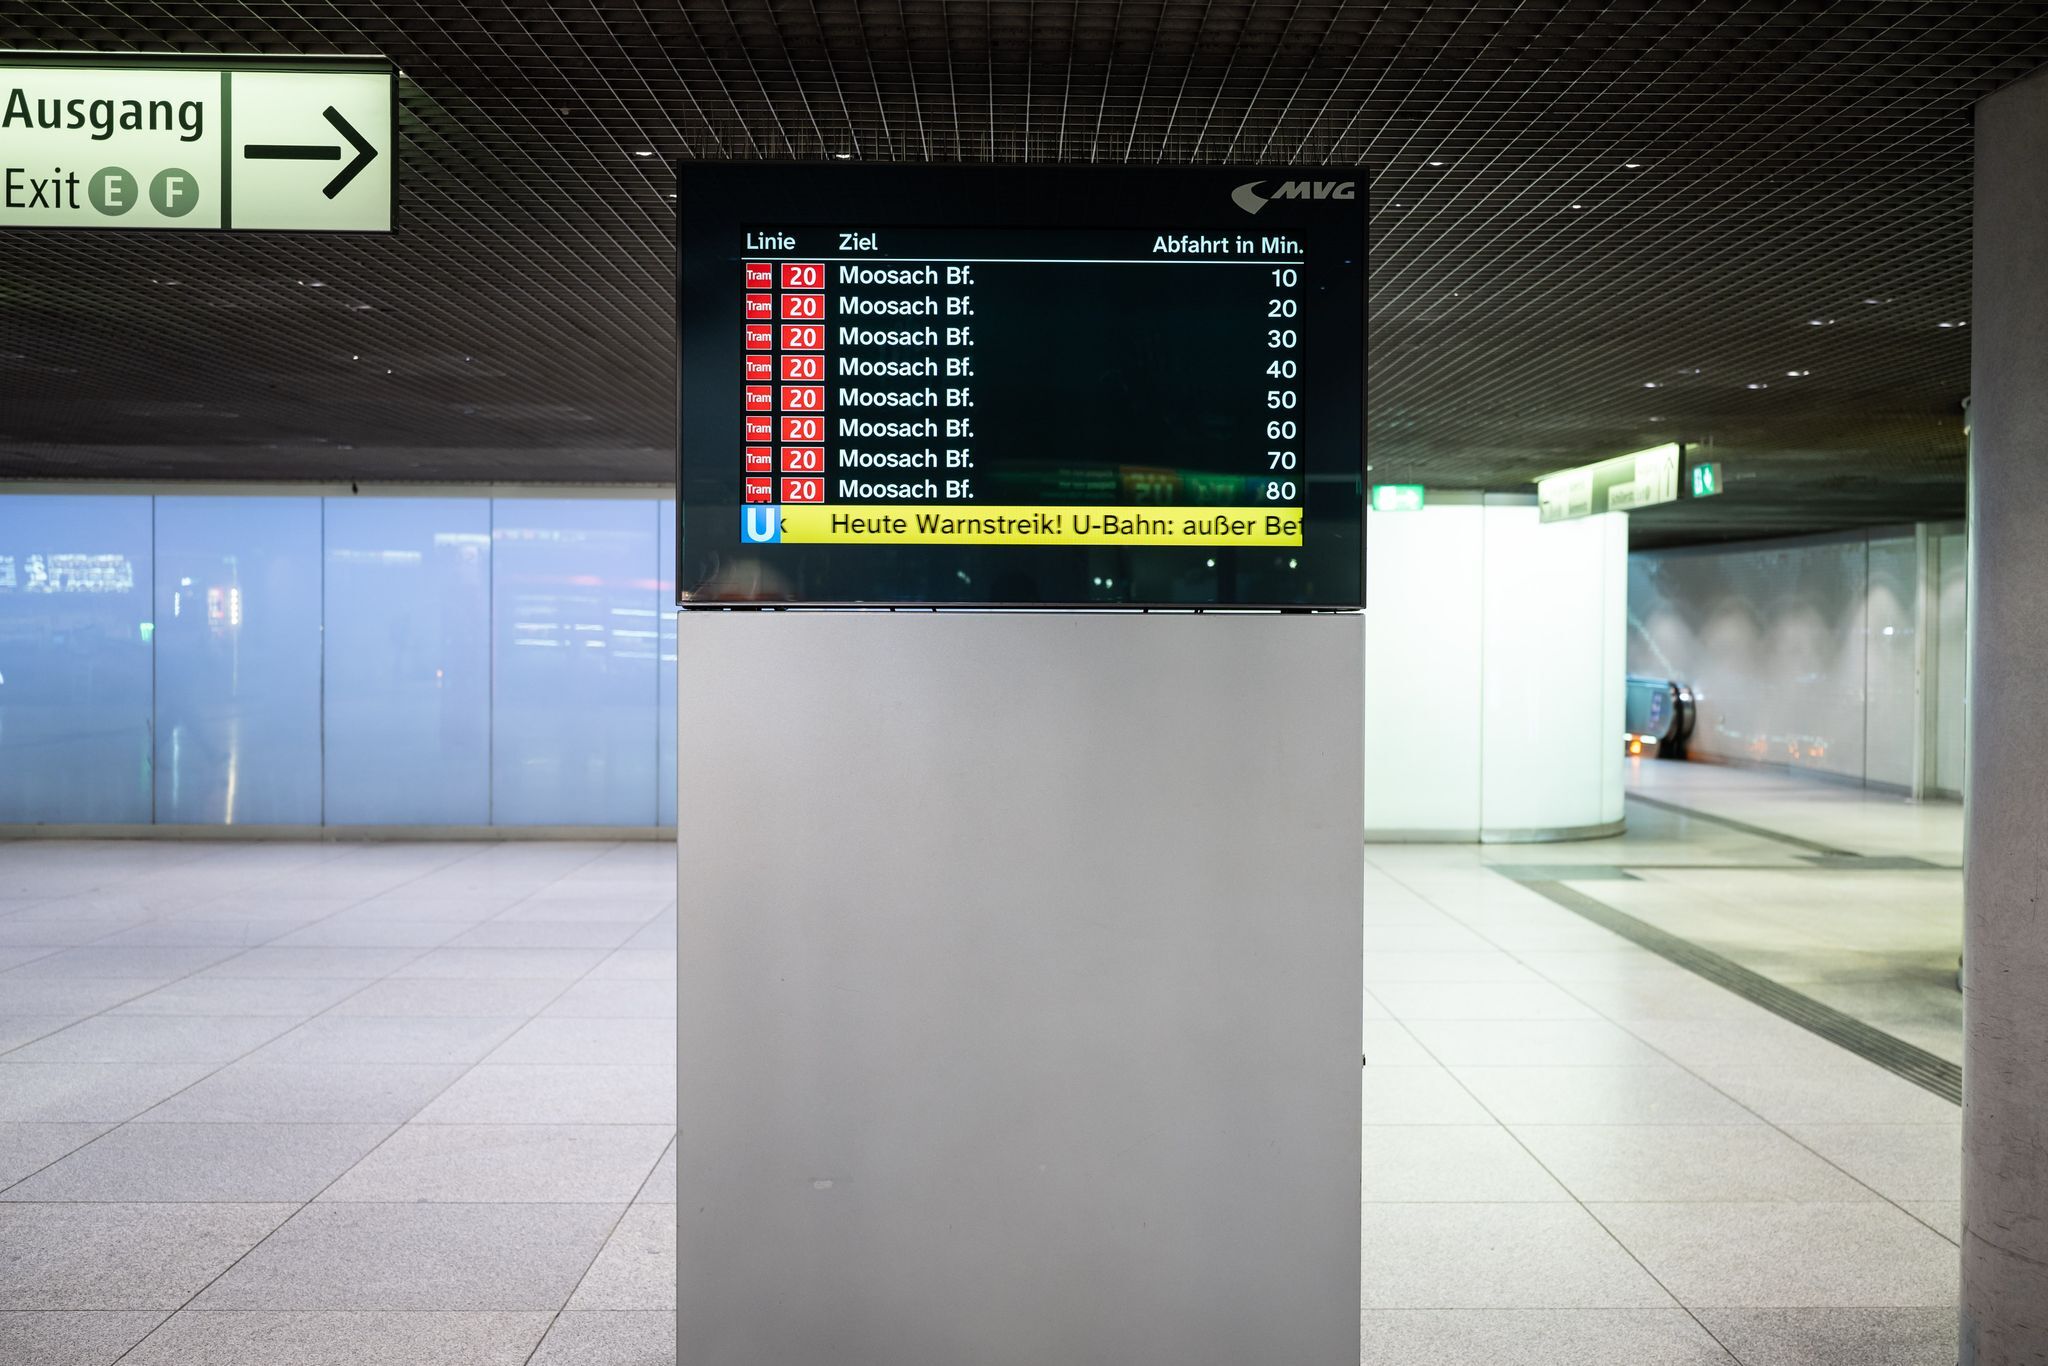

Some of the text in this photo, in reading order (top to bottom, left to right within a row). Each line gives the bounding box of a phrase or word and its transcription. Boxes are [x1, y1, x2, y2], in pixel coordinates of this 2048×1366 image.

[2, 88, 203, 142] Ausgang
[5, 167, 184, 209] Exit E F
[1270, 181, 1355, 199] MVG
[746, 231, 1304, 254] Linie Ziel Abfahrt in Min.
[746, 265, 1297, 288] Tram 20 Moosach Bf. 10
[746, 296, 1297, 318] Tram 20 Moosach Bf. 20
[746, 326, 1297, 348] Tram 20 Moosach Bf. 30
[746, 356, 1297, 379] Tram 20 Moosach Bf. 40
[746, 387, 1297, 410] Tram 20 Moosach Bf. 50
[746, 418, 1297, 440] Tram 20 Moosach Bf. 60
[746, 448, 1297, 470] Tram 20 Moosach Bf. 70
[746, 478, 1297, 501] Tram 20 Moosach Bf. 80
[747, 507, 775, 542] U
[832, 513, 907, 534] Heute
[916, 513, 1062, 536] Warnstreik!
[1073, 514, 1174, 536] U-Bahn:
[1183, 515, 1256, 536] außer
